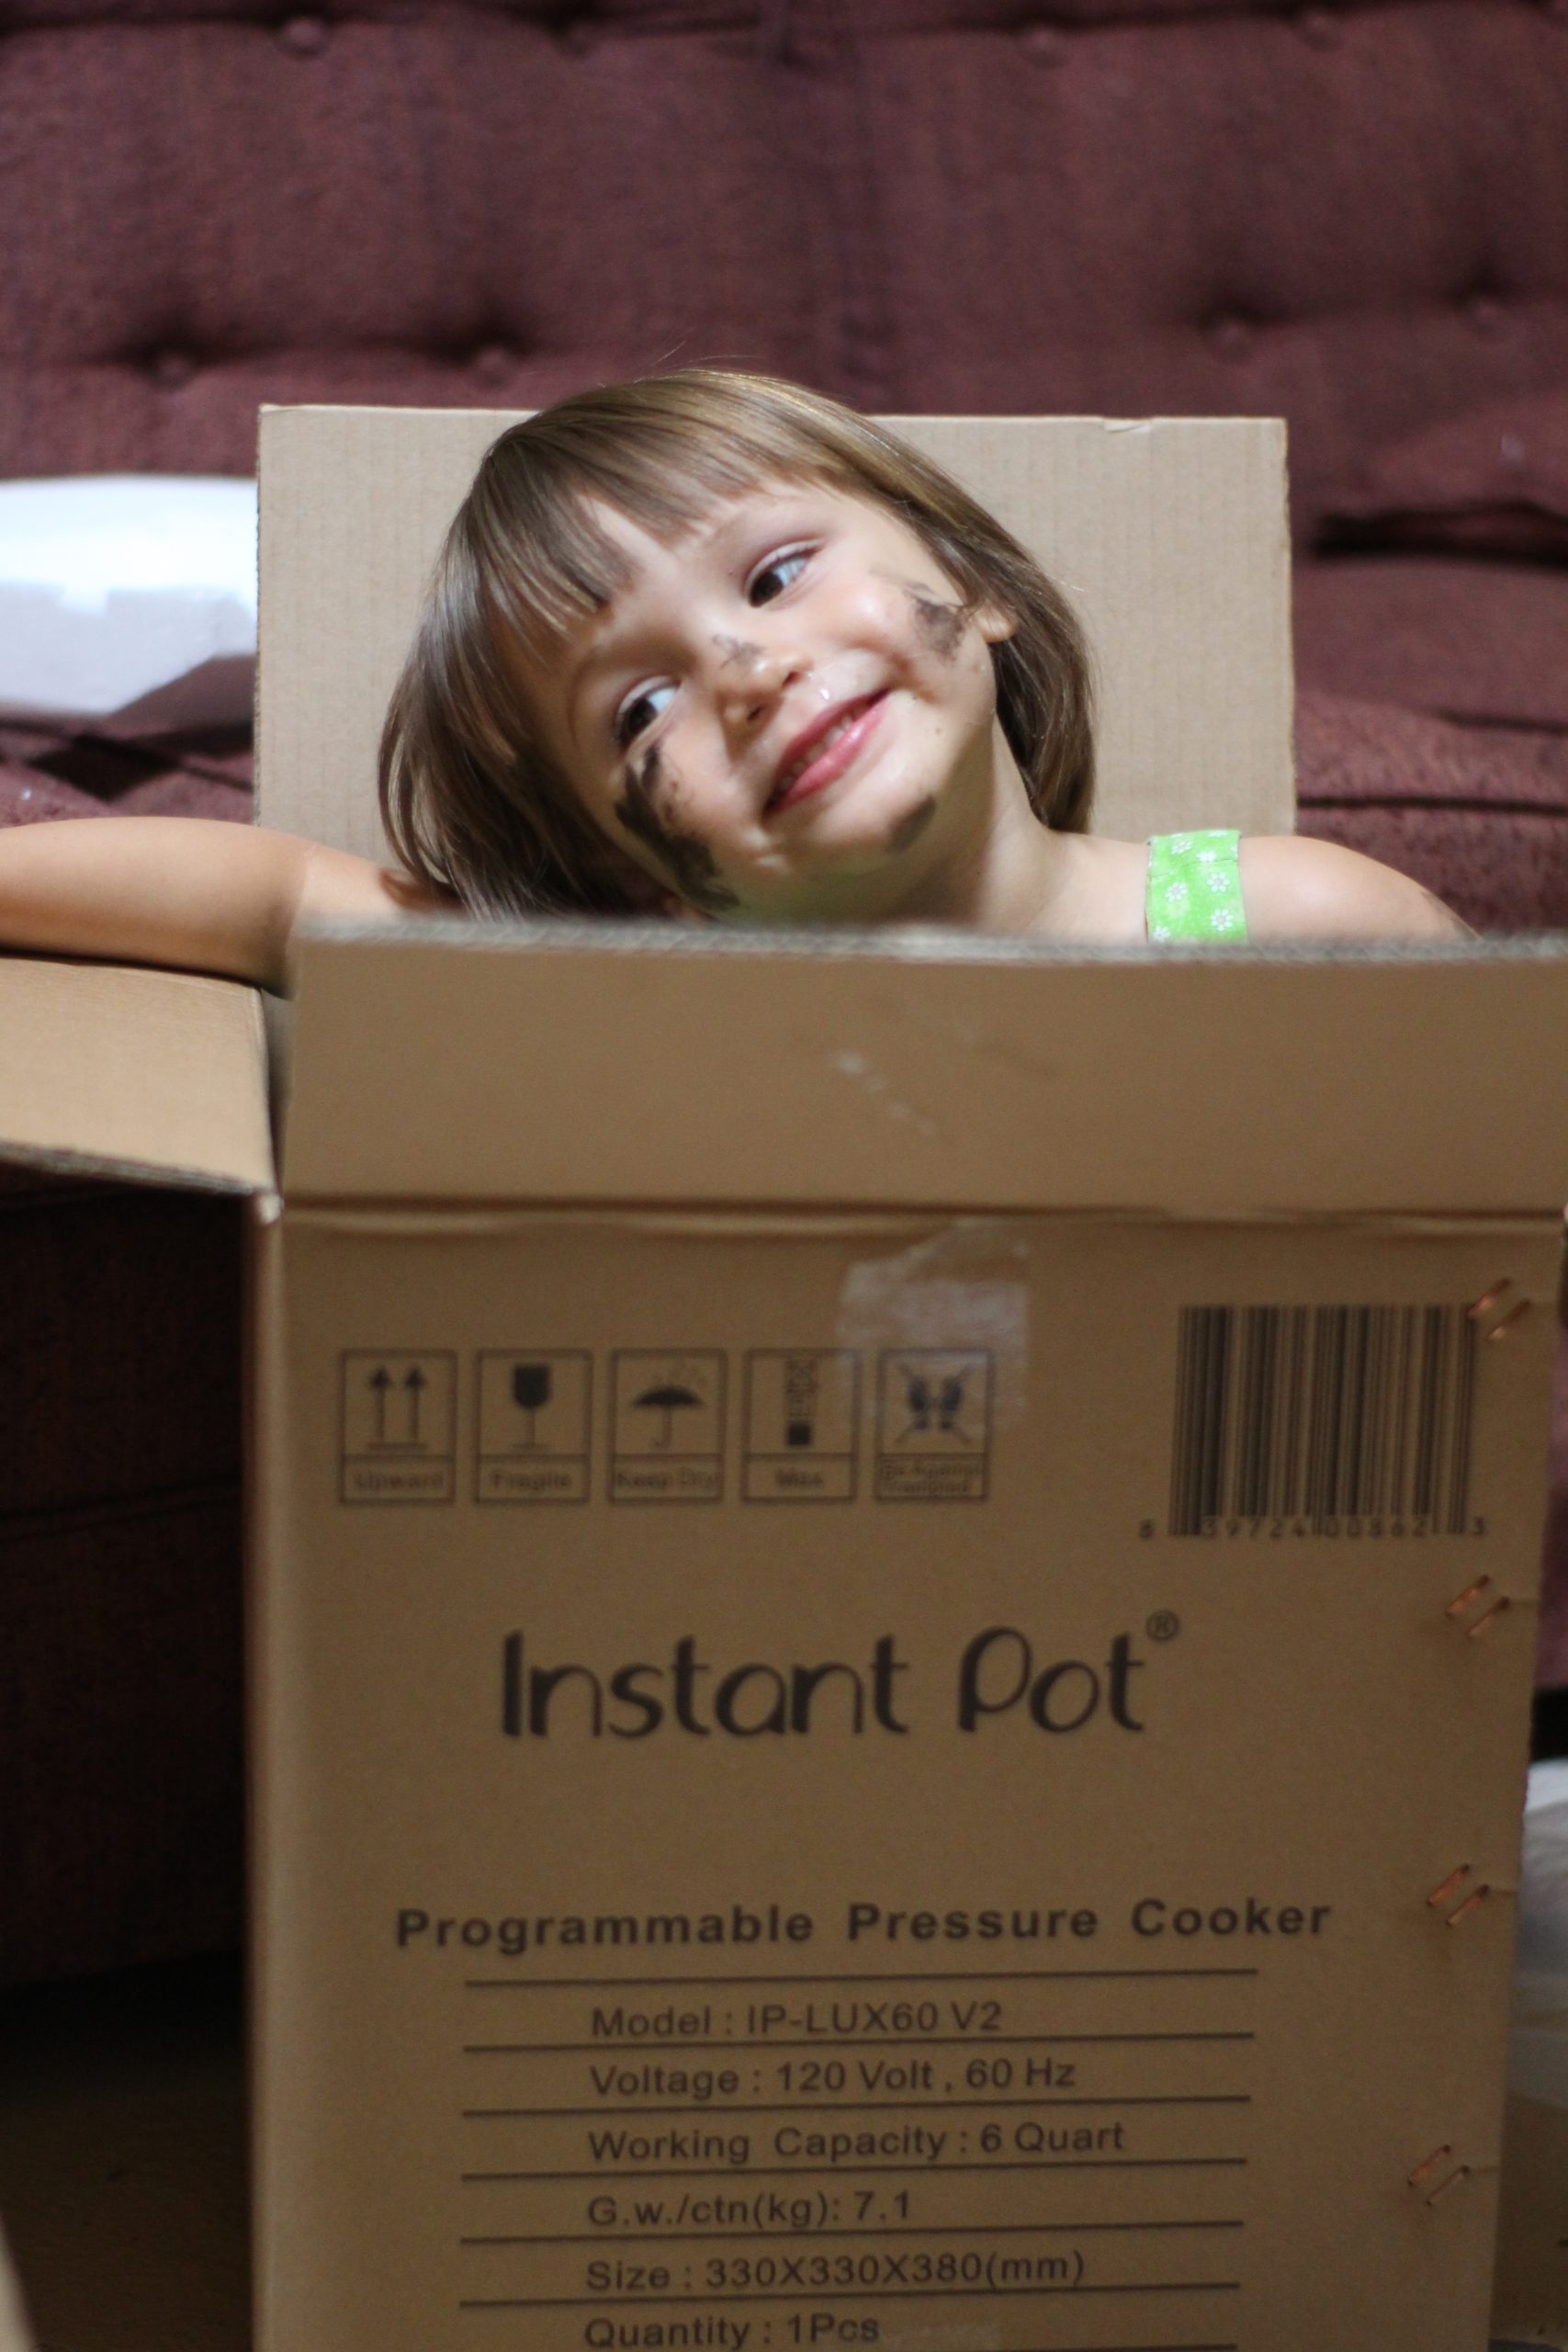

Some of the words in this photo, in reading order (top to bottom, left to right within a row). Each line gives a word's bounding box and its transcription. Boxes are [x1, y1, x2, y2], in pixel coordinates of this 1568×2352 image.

[500, 1630, 909, 1741] Instant
[395, 1903, 814, 1959] Programmable
[848, 1902, 1099, 1942] Pressure
[1130, 1896, 1332, 1939] Cooker
[592, 2006, 711, 2038] Model
[748, 2003, 939, 2034] IP-LUX60
[951, 2000, 1002, 2031] V2
[590, 2064, 740, 2101] Voltage
[778, 2062, 846, 2092] 120
[858, 2060, 932, 2091] Volt
[965, 2058, 1013, 2089] 60
[1025, 2057, 1076, 2088] Hz
[588, 2130, 750, 2166] Working
[773, 2125, 947, 2164] Capacity
[979, 2123, 1002, 2154] 6
[1014, 2122, 1125, 2154] Quart
[854, 2190, 909, 2221] 7.1
[586, 2261, 671, 2291] Size
[706, 2249, 1085, 2290] 330X330X380(mm)
[583, 2316, 750, 2352] Quantity
[787, 2313, 879, 2344] 1Pcs
